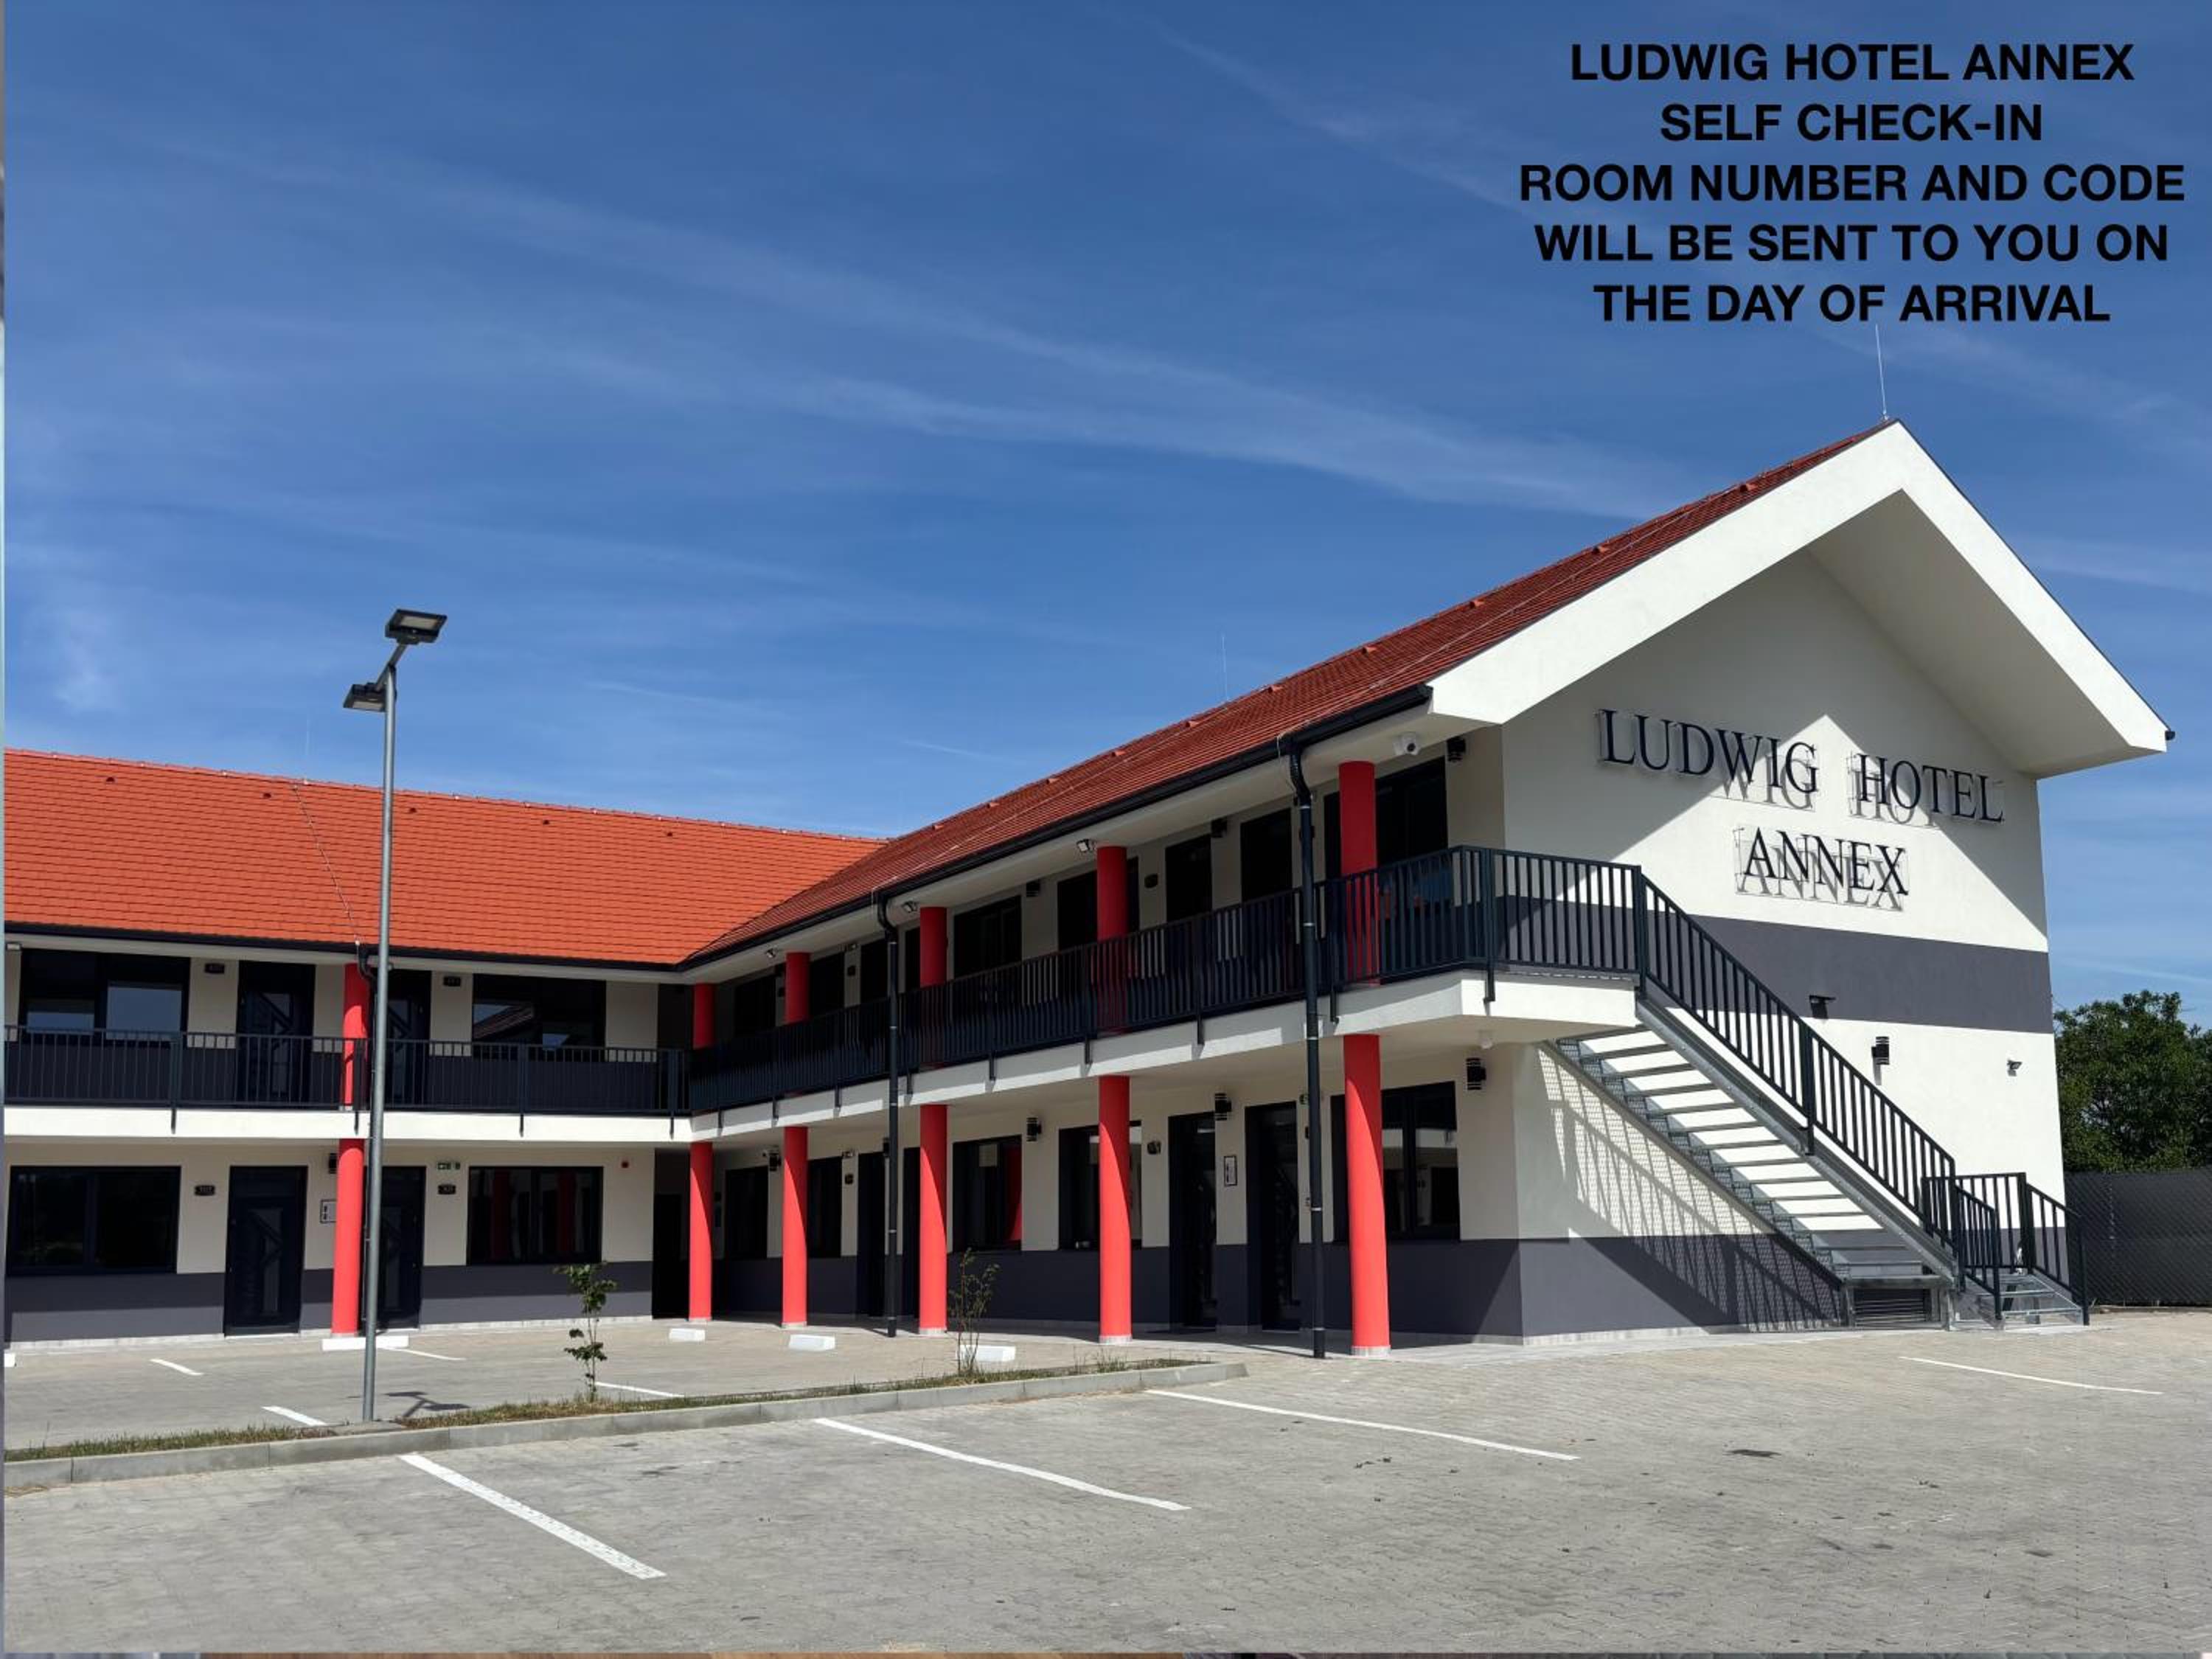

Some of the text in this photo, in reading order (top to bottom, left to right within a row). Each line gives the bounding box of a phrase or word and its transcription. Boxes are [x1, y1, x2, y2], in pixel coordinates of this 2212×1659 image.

[1599, 709, 2004, 823] LUDWIG HOTEL
[1745, 827, 1909, 896] ANNEX
